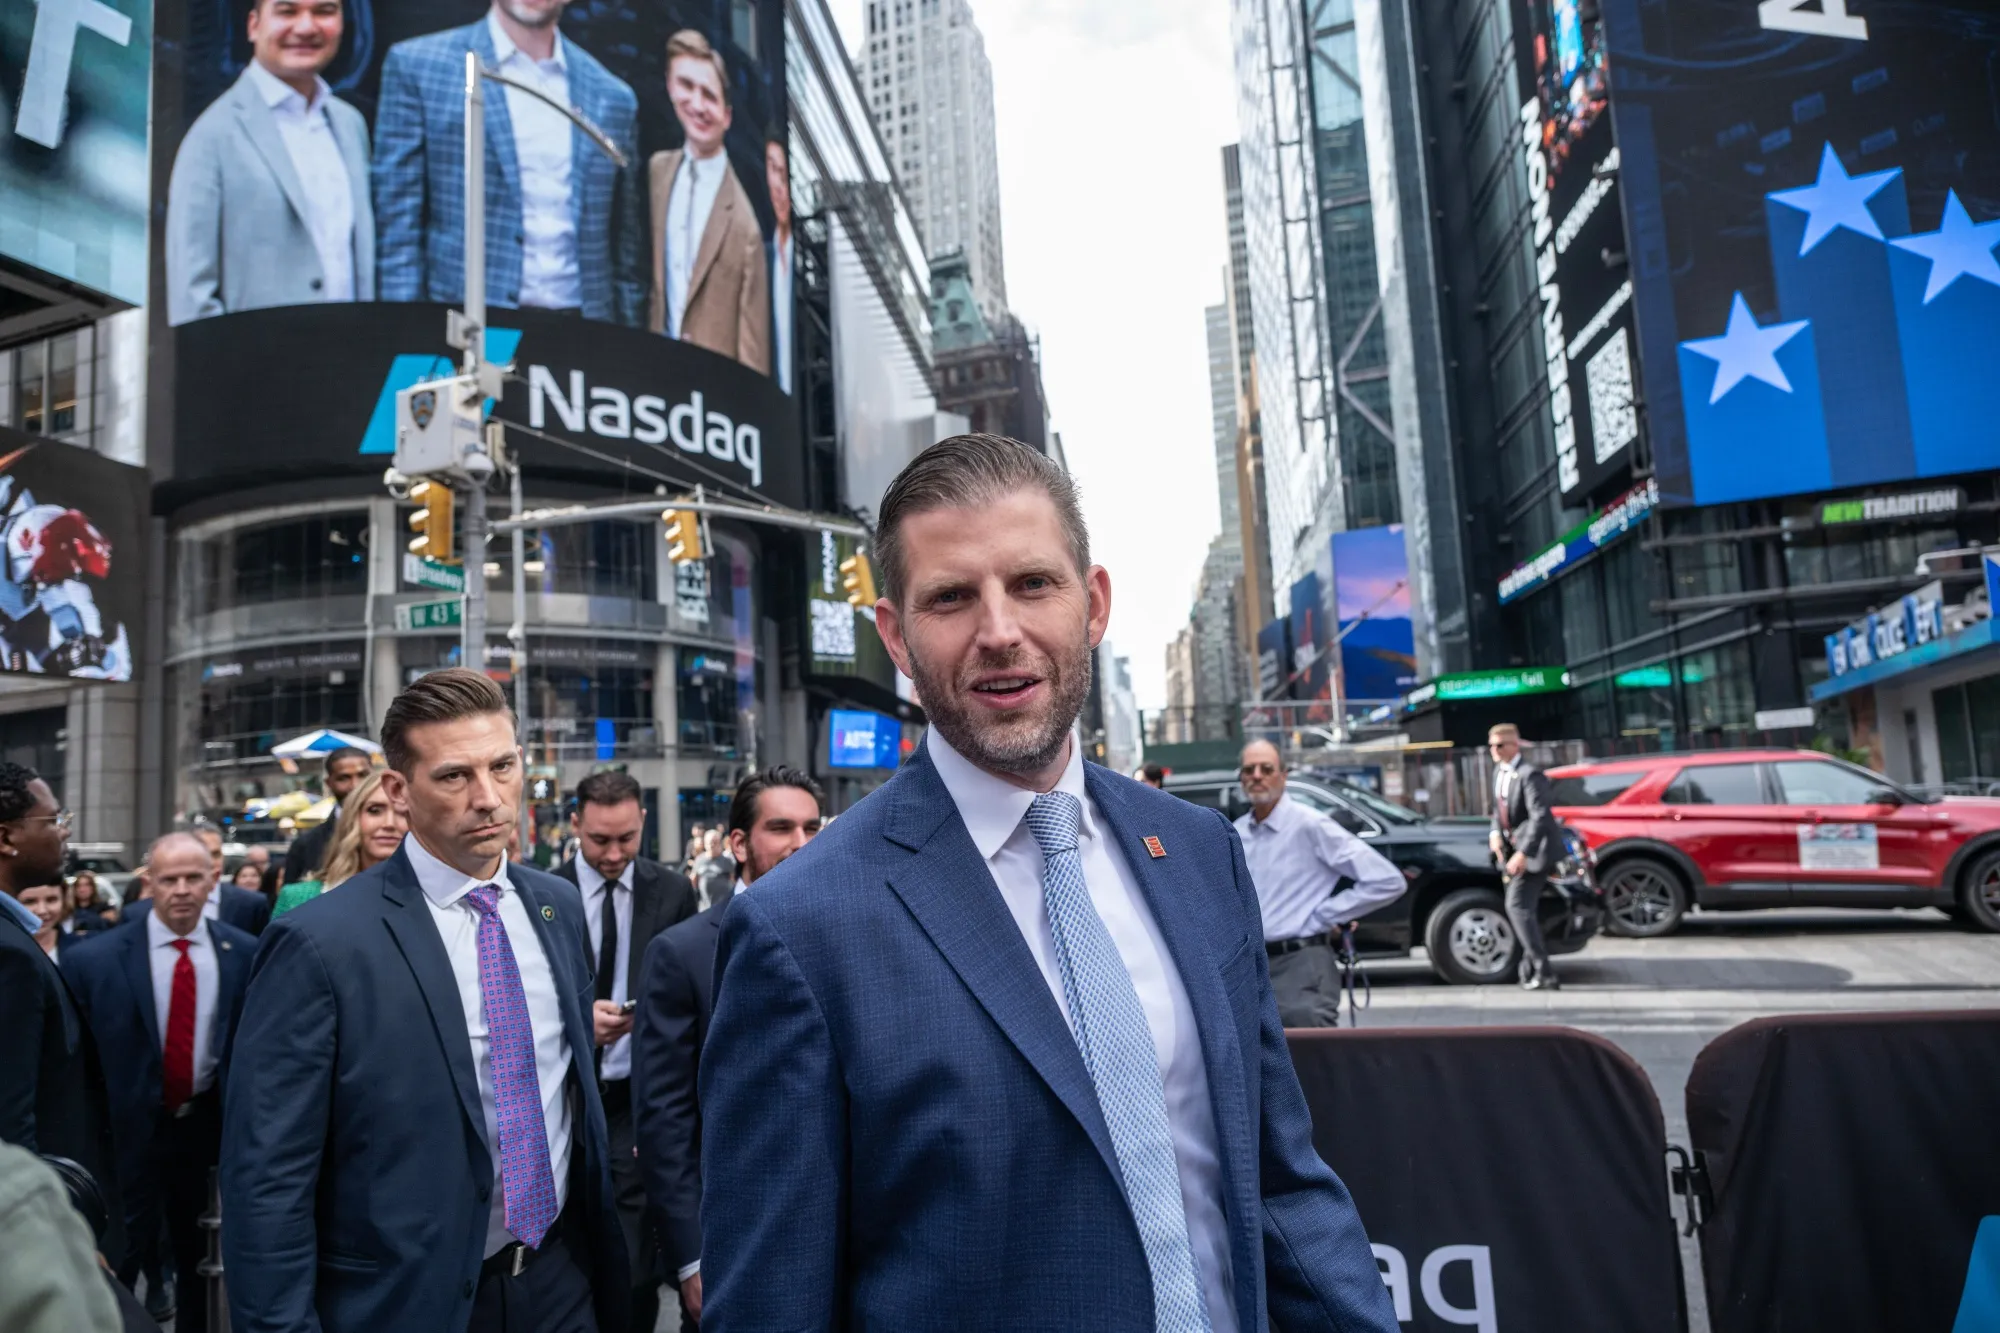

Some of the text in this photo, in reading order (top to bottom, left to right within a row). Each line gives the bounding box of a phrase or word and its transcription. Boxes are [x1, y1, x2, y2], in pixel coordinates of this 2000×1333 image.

[1520, 96, 1580, 494] RESERVE NOW
[528, 364, 762, 487] Nasdaq
[1588, 503, 1628, 547] opening
[431, 603, 449, 624] 43
[1521, 671, 1545, 687] fall
